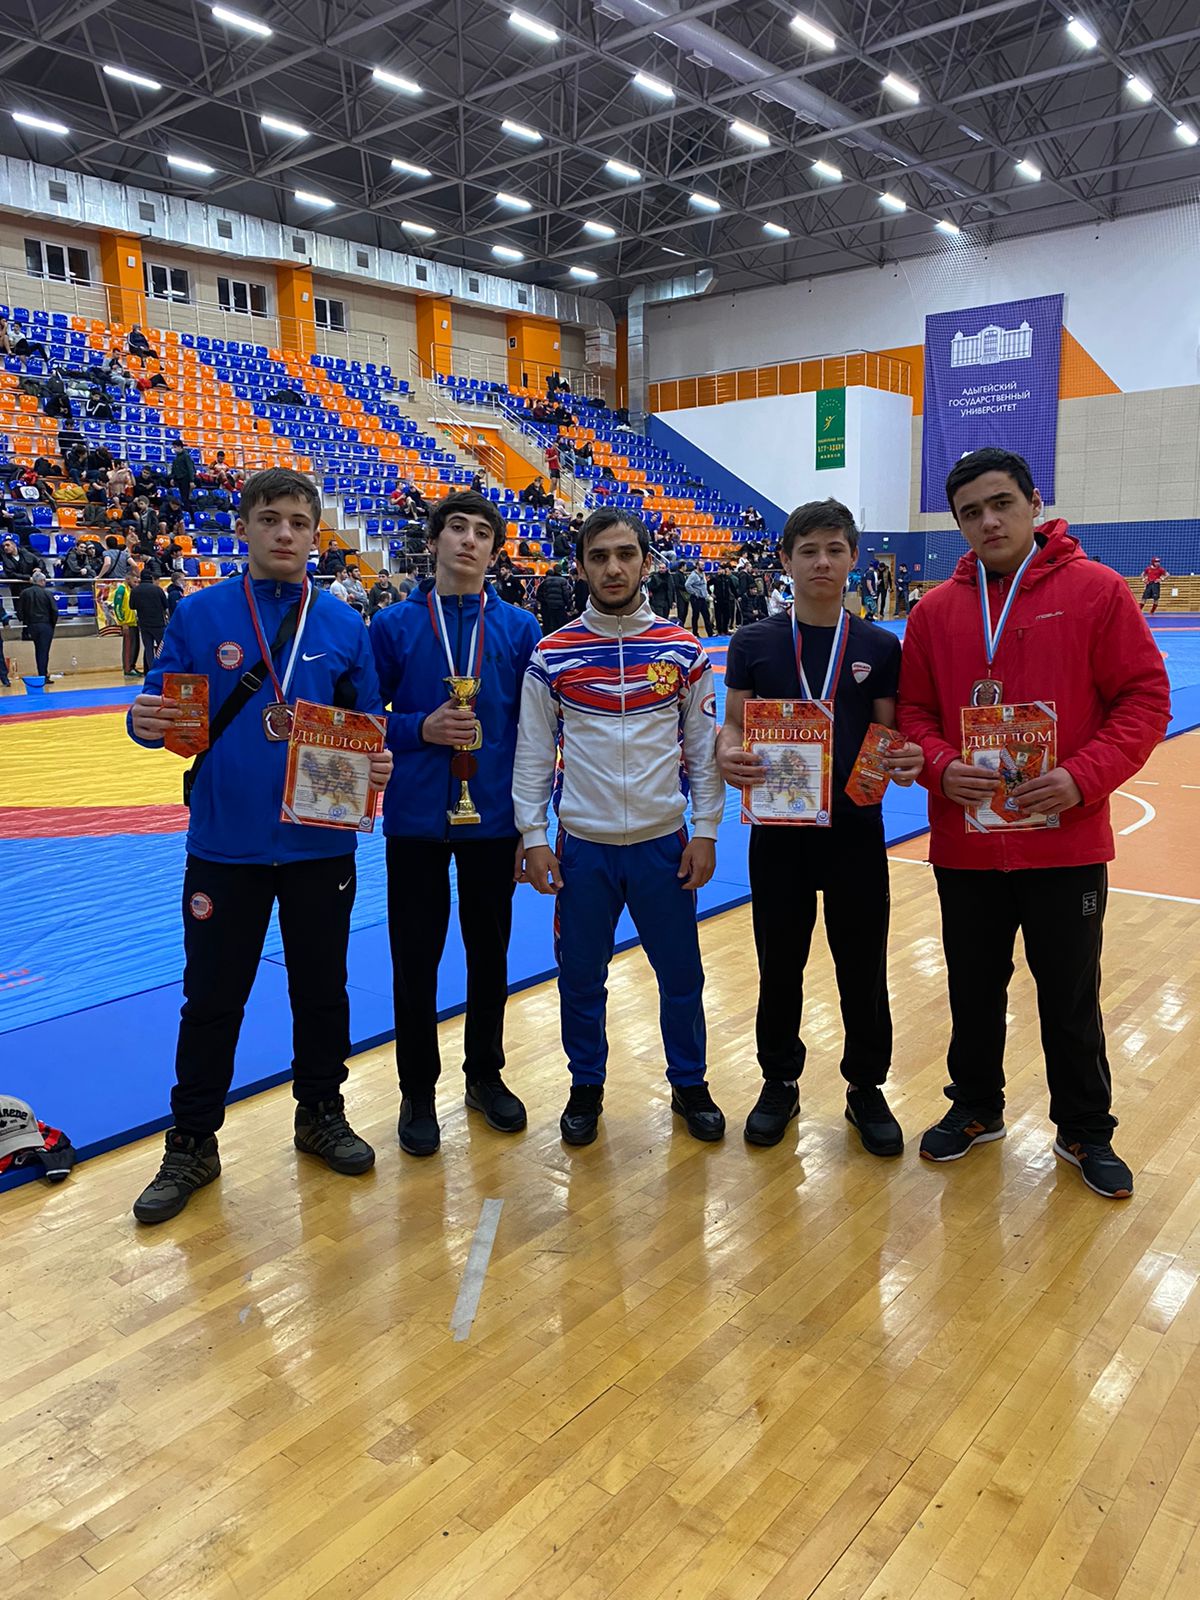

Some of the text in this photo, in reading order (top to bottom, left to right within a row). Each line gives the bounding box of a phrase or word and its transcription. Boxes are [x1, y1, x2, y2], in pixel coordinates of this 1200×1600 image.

[961, 380, 1017, 396] АДЫГЕЙСКИЙ
[948, 389, 1031, 407] ГОСУДАРСТВЕННЫЙ
[960, 403, 1017, 418] УНИВЕРСИТЕТ
[294, 729, 379, 752] ДИПЛОМ
[747, 728, 828, 741] ДИПЛОМ
